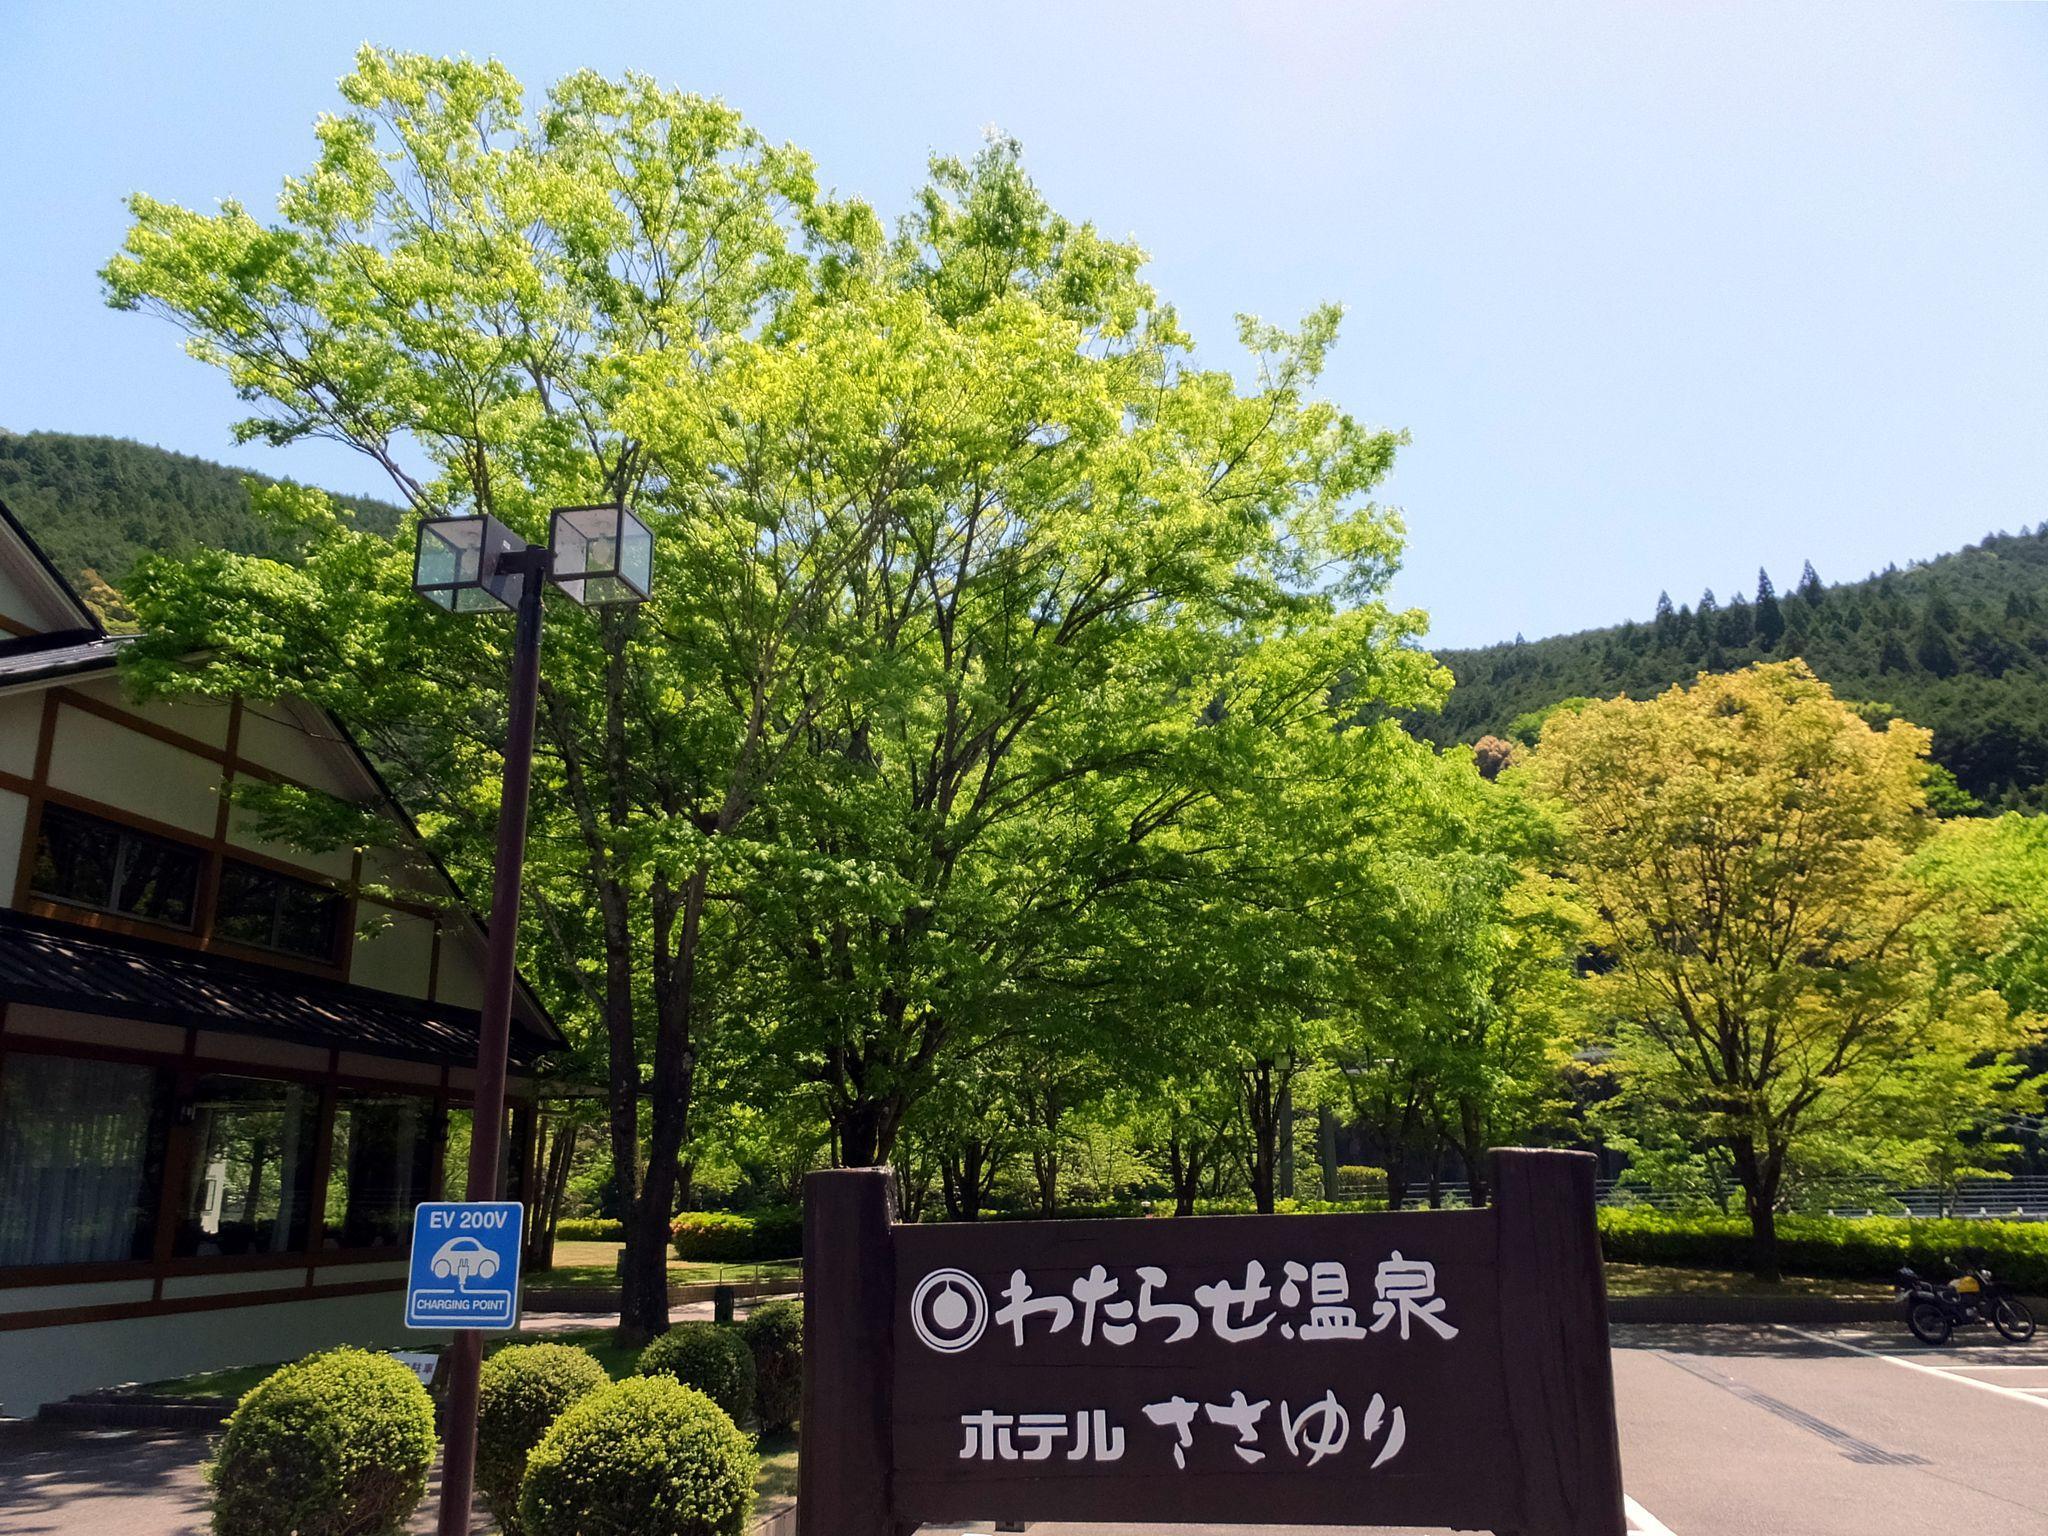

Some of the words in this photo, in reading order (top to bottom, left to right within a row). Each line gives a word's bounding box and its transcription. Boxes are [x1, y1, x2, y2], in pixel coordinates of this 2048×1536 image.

[430, 1211, 456, 1229] EV
[460, 1211, 508, 1229] 200V
[417, 1299, 470, 1310] CHARGING
[473, 1300, 504, 1310] POINT
[993, 1250, 1459, 1347] わたらせ温泉
